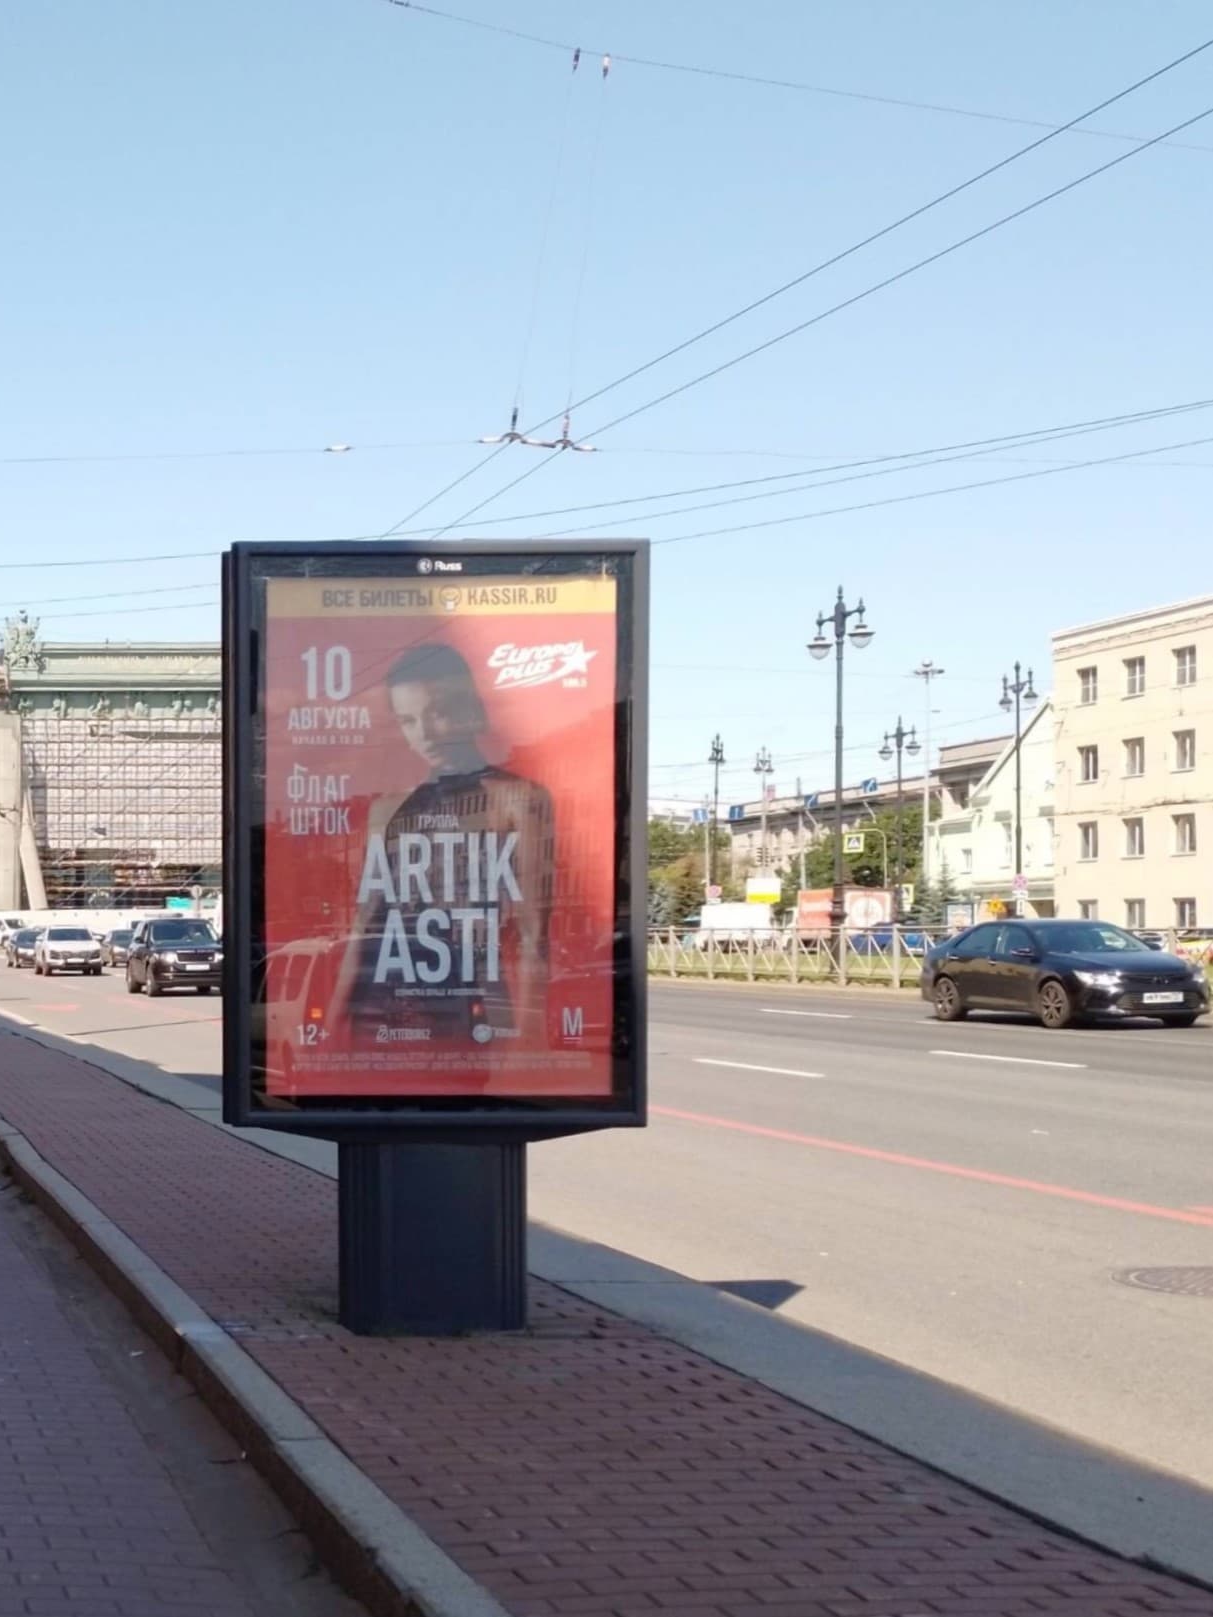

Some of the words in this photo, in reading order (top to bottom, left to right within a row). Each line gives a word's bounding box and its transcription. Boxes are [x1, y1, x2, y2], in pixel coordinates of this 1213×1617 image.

[321, 589, 354, 608] ВСЕ
[359, 588, 434, 608] БИЛЕТЫ
[300, 645, 352, 701] 10
[288, 706, 371, 731] АВГУСТА
[287, 763, 350, 804] ФЛАГ
[291, 807, 350, 836] ШТОК
[418, 815, 460, 829] ГРУППА
[356, 831, 524, 904] ARTIK
[373, 907, 500, 984] ASTI
[296, 1024, 331, 1046] 12+
